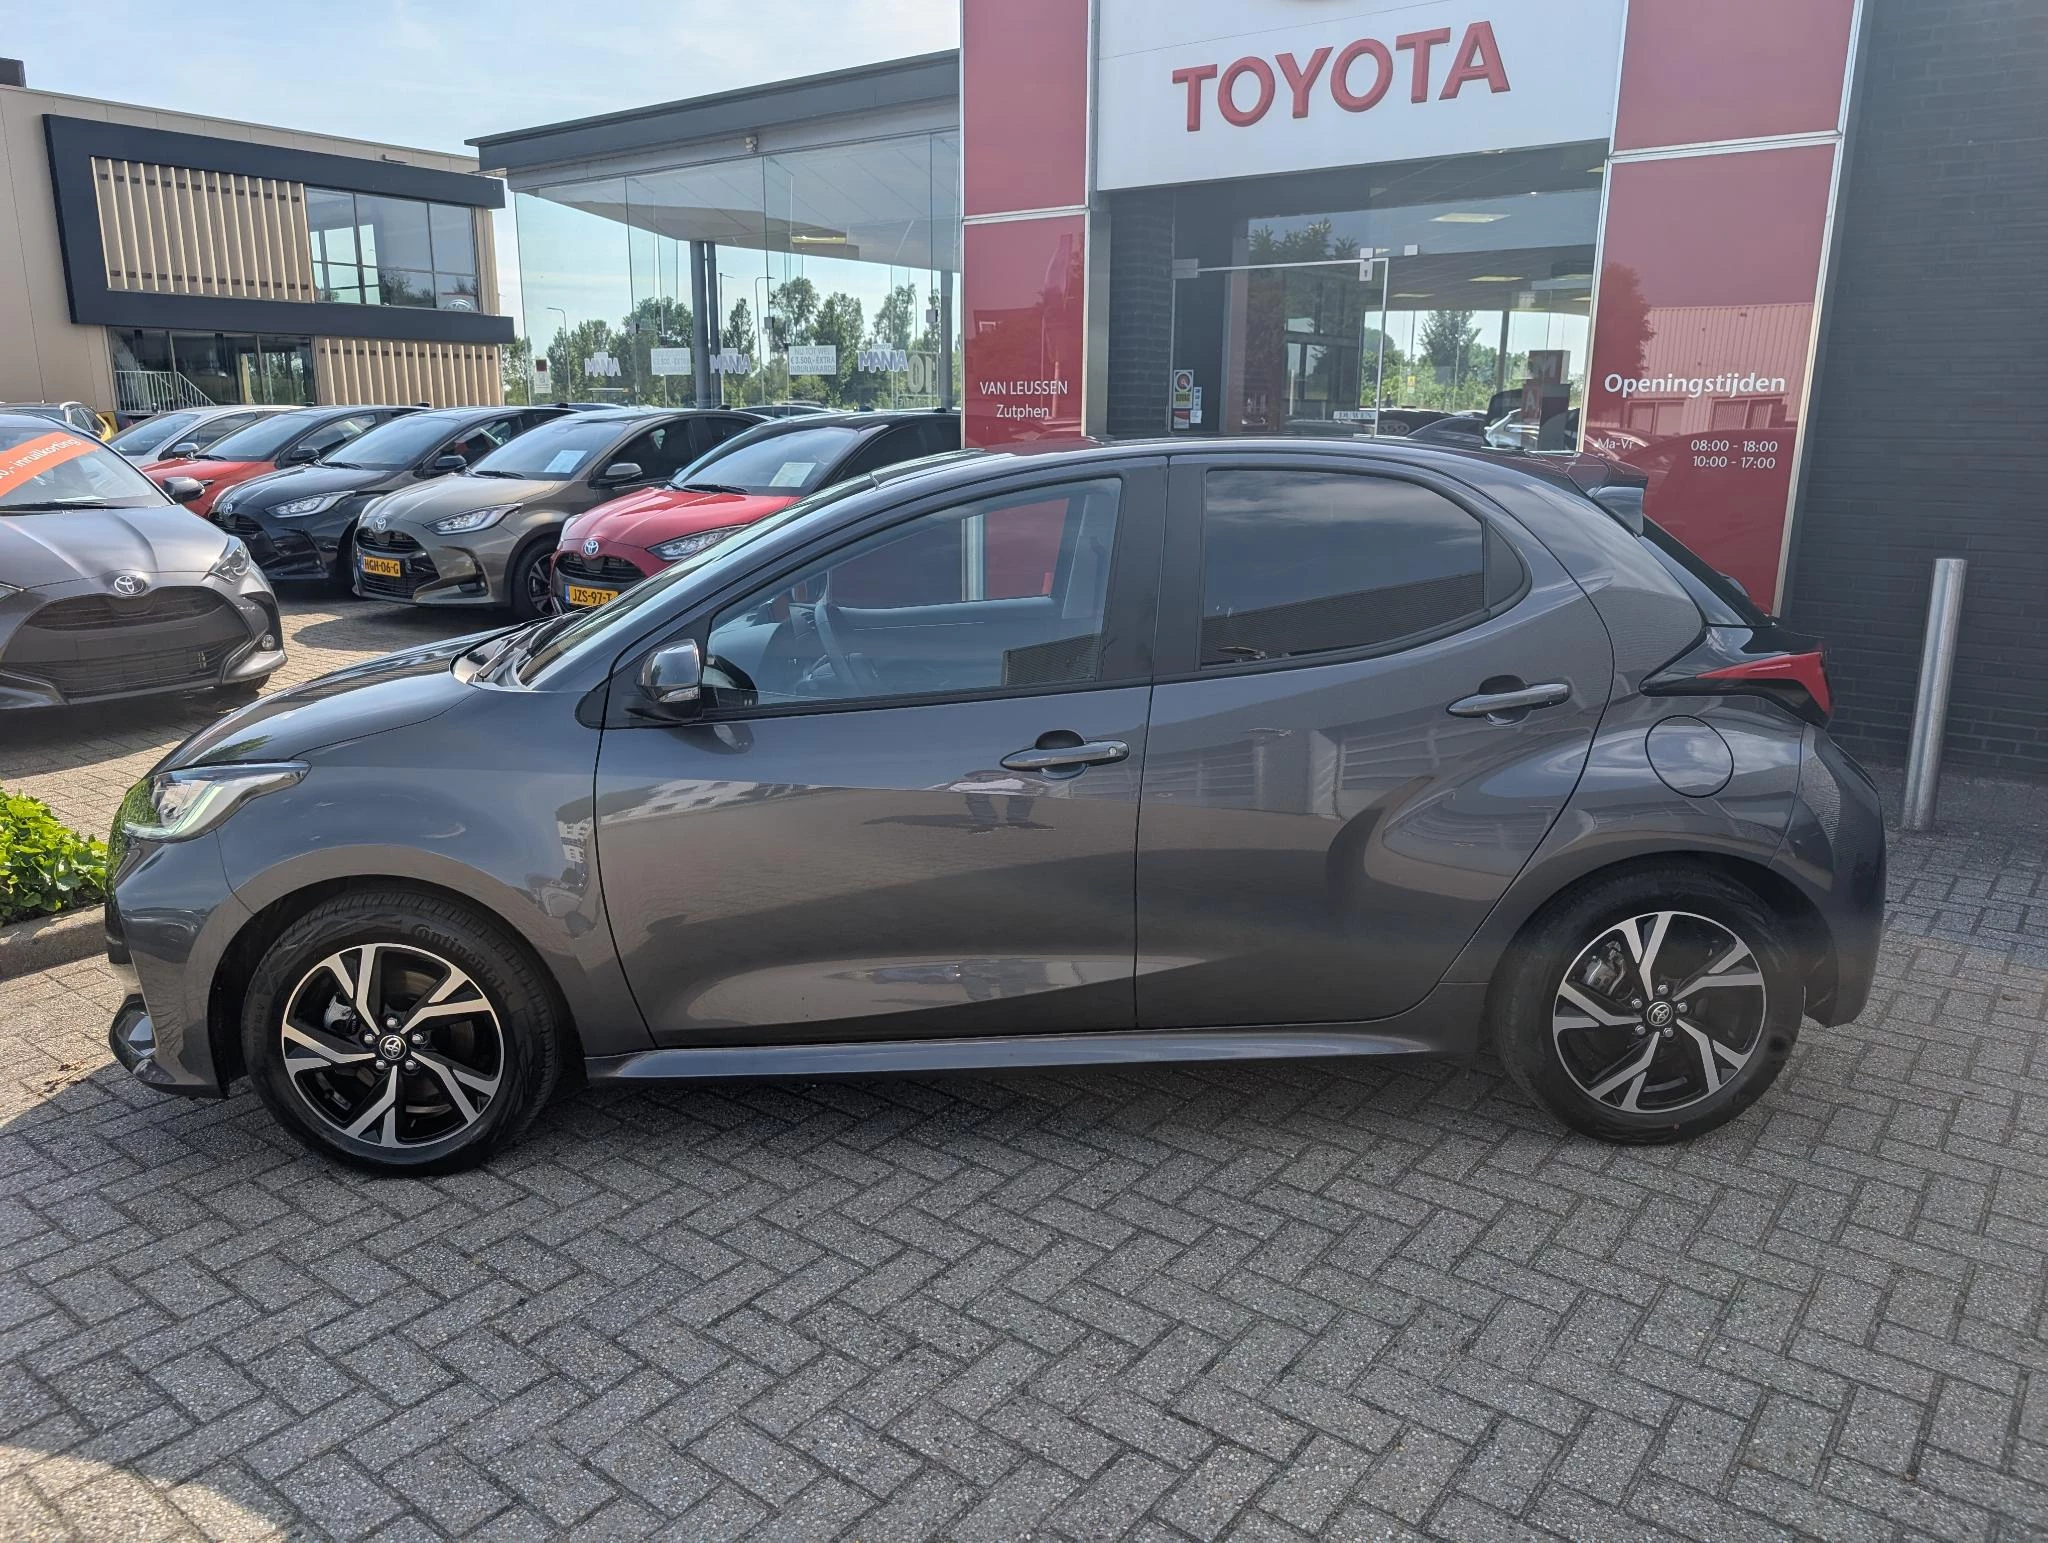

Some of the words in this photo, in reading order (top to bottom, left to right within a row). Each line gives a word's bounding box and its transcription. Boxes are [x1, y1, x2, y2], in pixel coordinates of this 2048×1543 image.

[1171, 20, 1511, 132] TOYOTA
[584, 357, 622, 376] MANIA
[710, 353, 753, 374] MANIA
[816, 356, 835, 364] EXTRA
[858, 350, 909, 373] MANIA
[980, 381, 1006, 395] VAN
[1010, 380, 1068, 395] LEUSSEN
[1604, 372, 1786, 398] Openingstijden
[996, 404, 1049, 421] Zutphen
[1597, 438, 1634, 449] Ma-Vr
[1690, 439, 1729, 452] 08:00
[1743, 440, 1778, 453] 18:00
[1693, 455, 1727, 468] 10:00
[1741, 456, 1776, 469] 17:00
[364, 558, 399, 575] HGH-06-G
[572, 589, 612, 604] JZS-97-T
